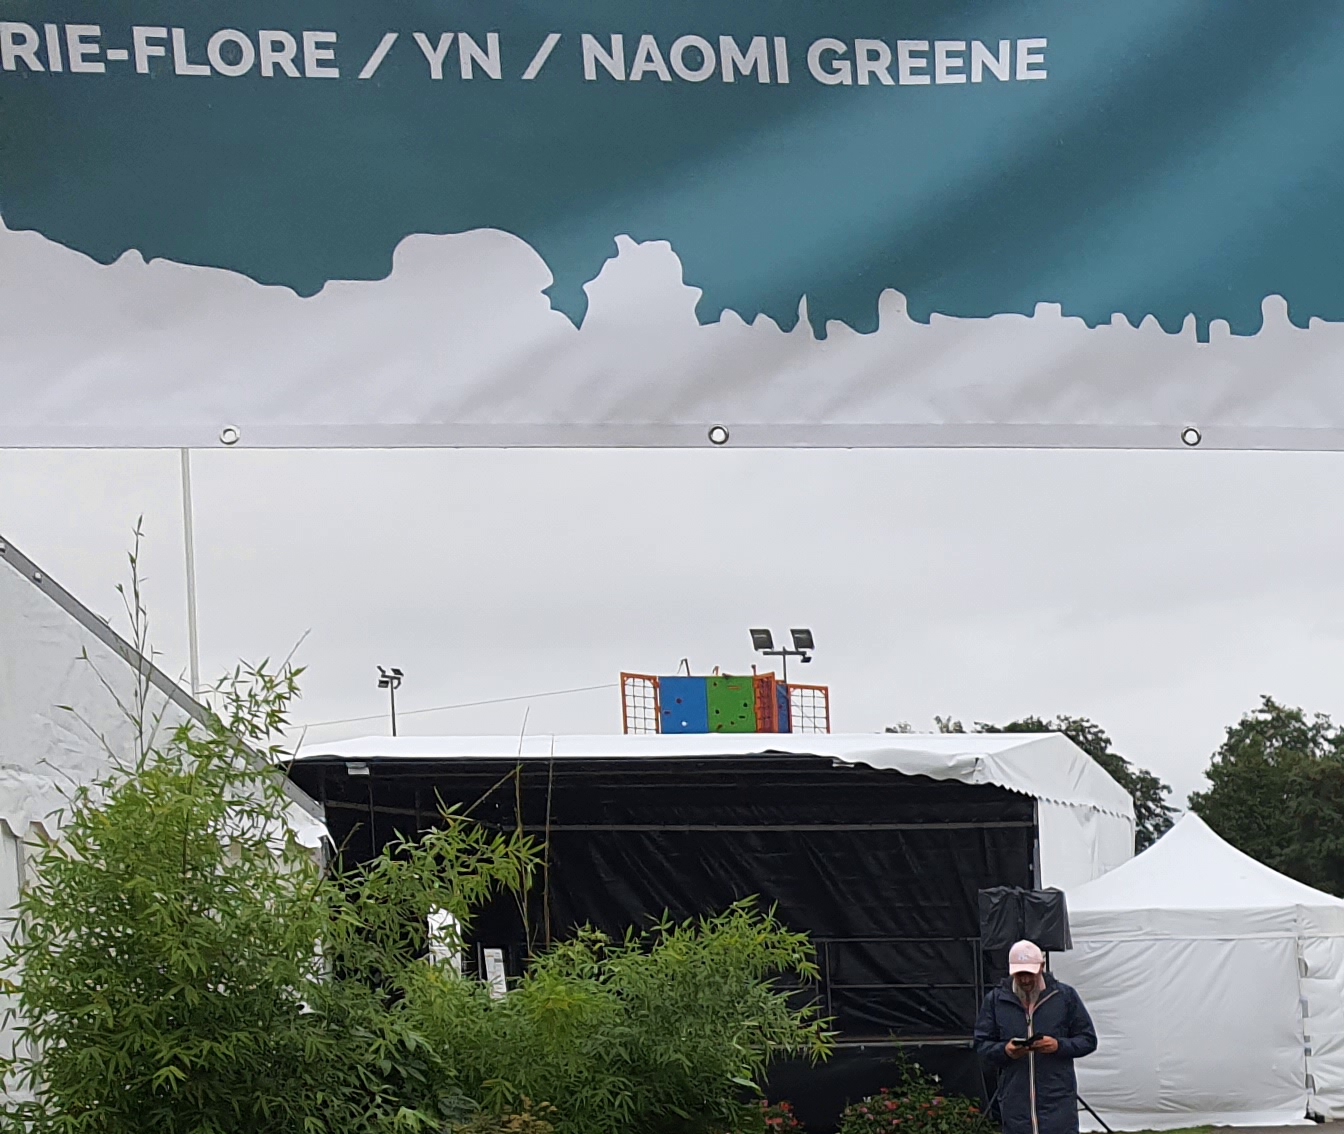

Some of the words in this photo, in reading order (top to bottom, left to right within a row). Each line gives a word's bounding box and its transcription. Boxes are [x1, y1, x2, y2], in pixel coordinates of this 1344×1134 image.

[414, 34, 504, 81] YN
[583, 34, 790, 85] NAOMI
[807, 37, 1048, 86] GREENE
